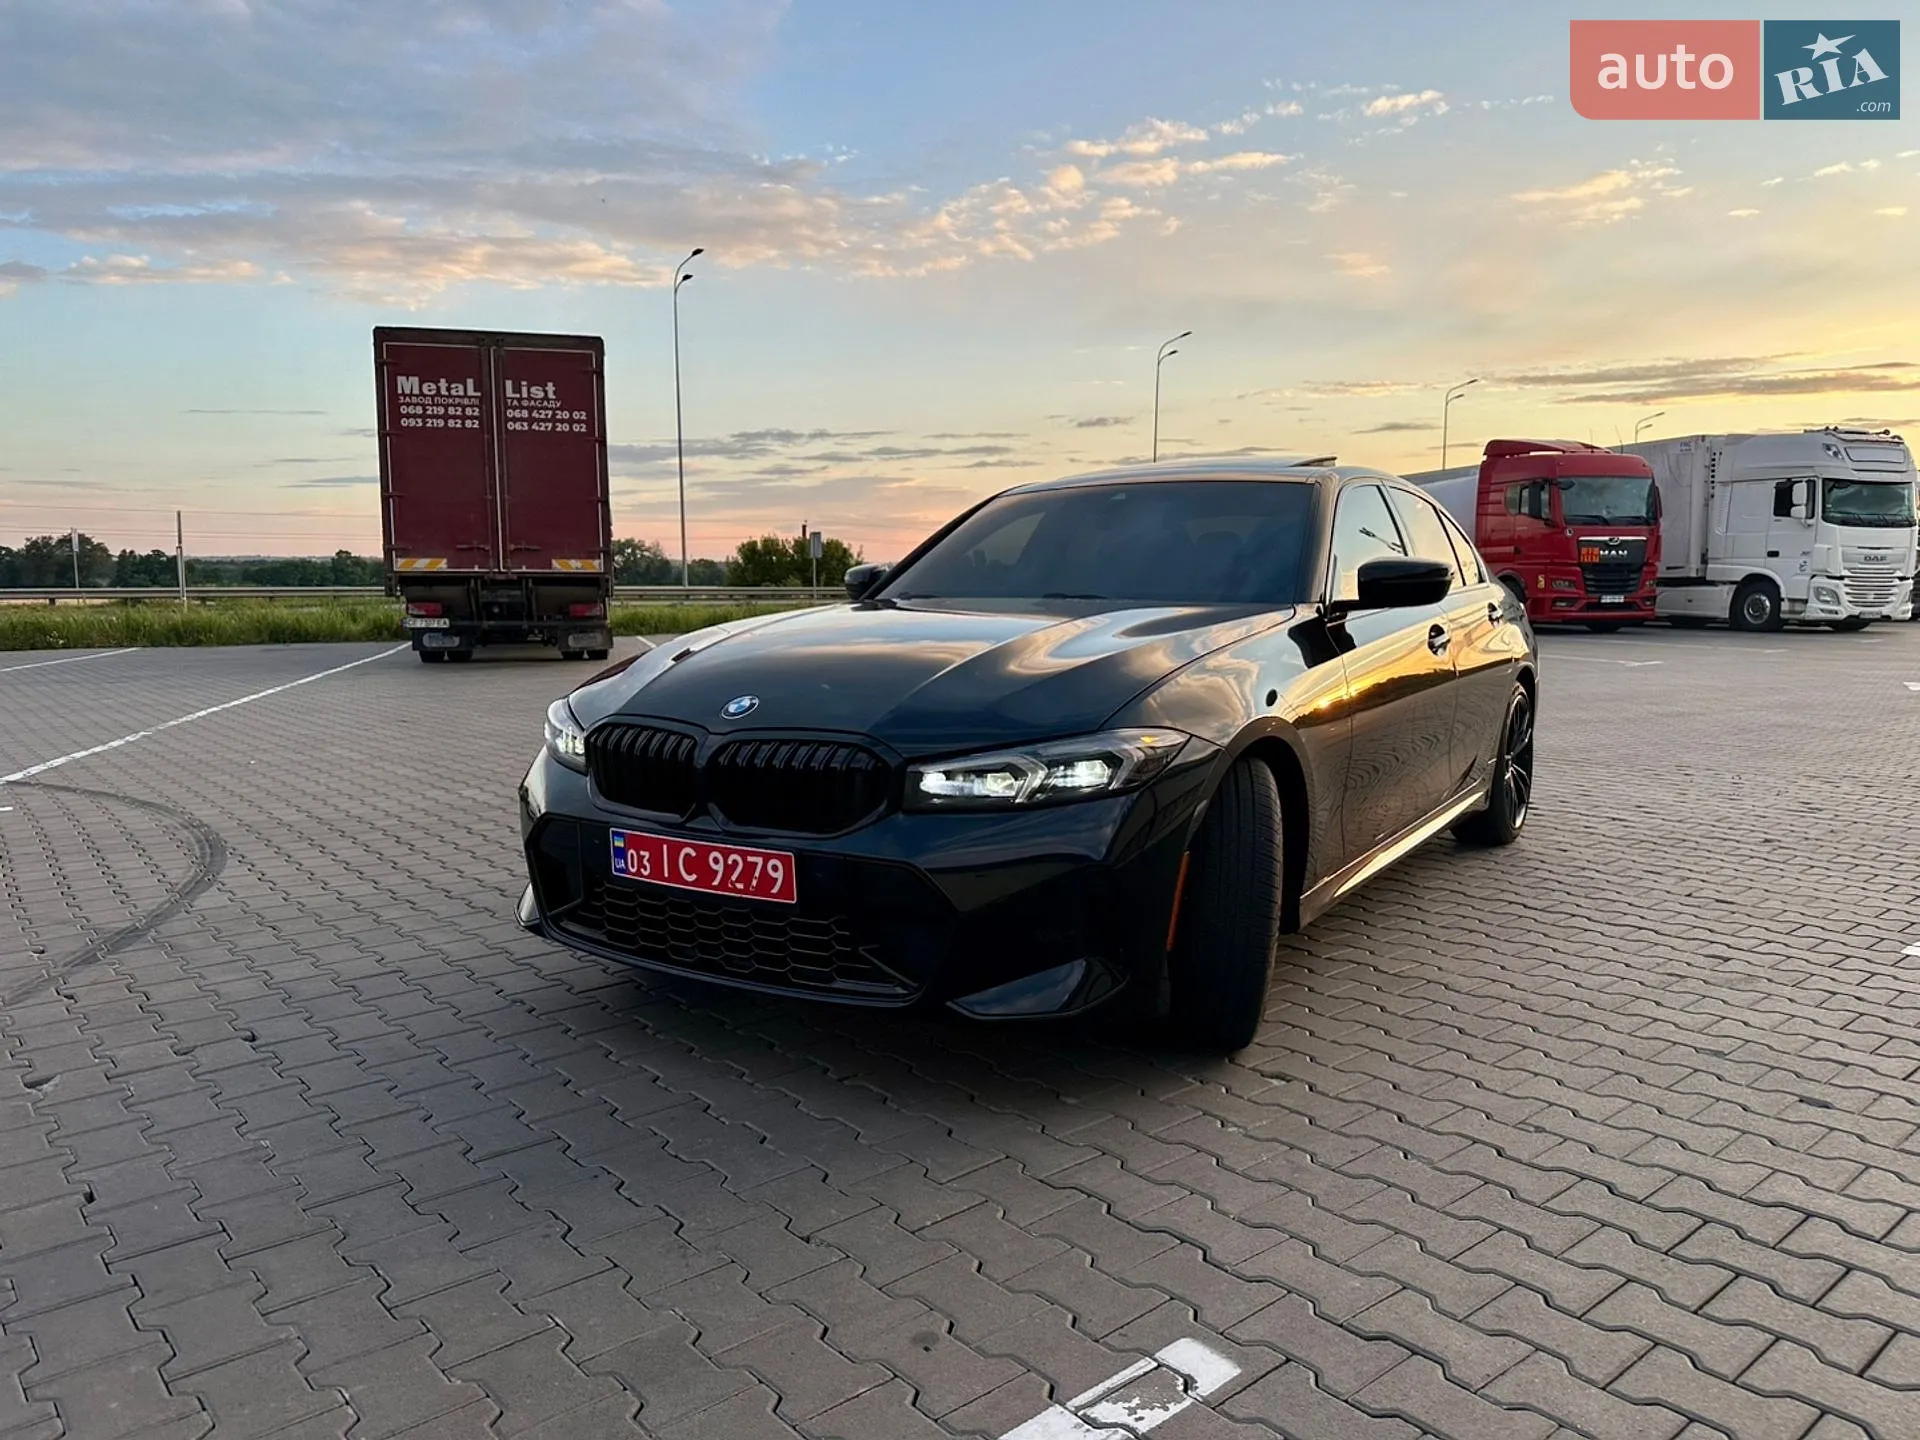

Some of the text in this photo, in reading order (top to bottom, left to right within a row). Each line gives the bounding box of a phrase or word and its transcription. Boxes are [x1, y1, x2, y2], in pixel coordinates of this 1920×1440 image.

[505, 379, 556, 399] List
[398, 396, 433, 405] ЗАВОД
[520, 400, 562, 408] ФАСАДУ
[399, 405, 480, 416] 068 219 82 82
[506, 409, 587, 420] 068 427 20 02
[400, 418, 480, 429] 093 219 82 82
[506, 422, 587, 432] 063 427 20 02
[614, 858, 626, 870] UA
[627, 844, 784, 894] 03 IC 9279
